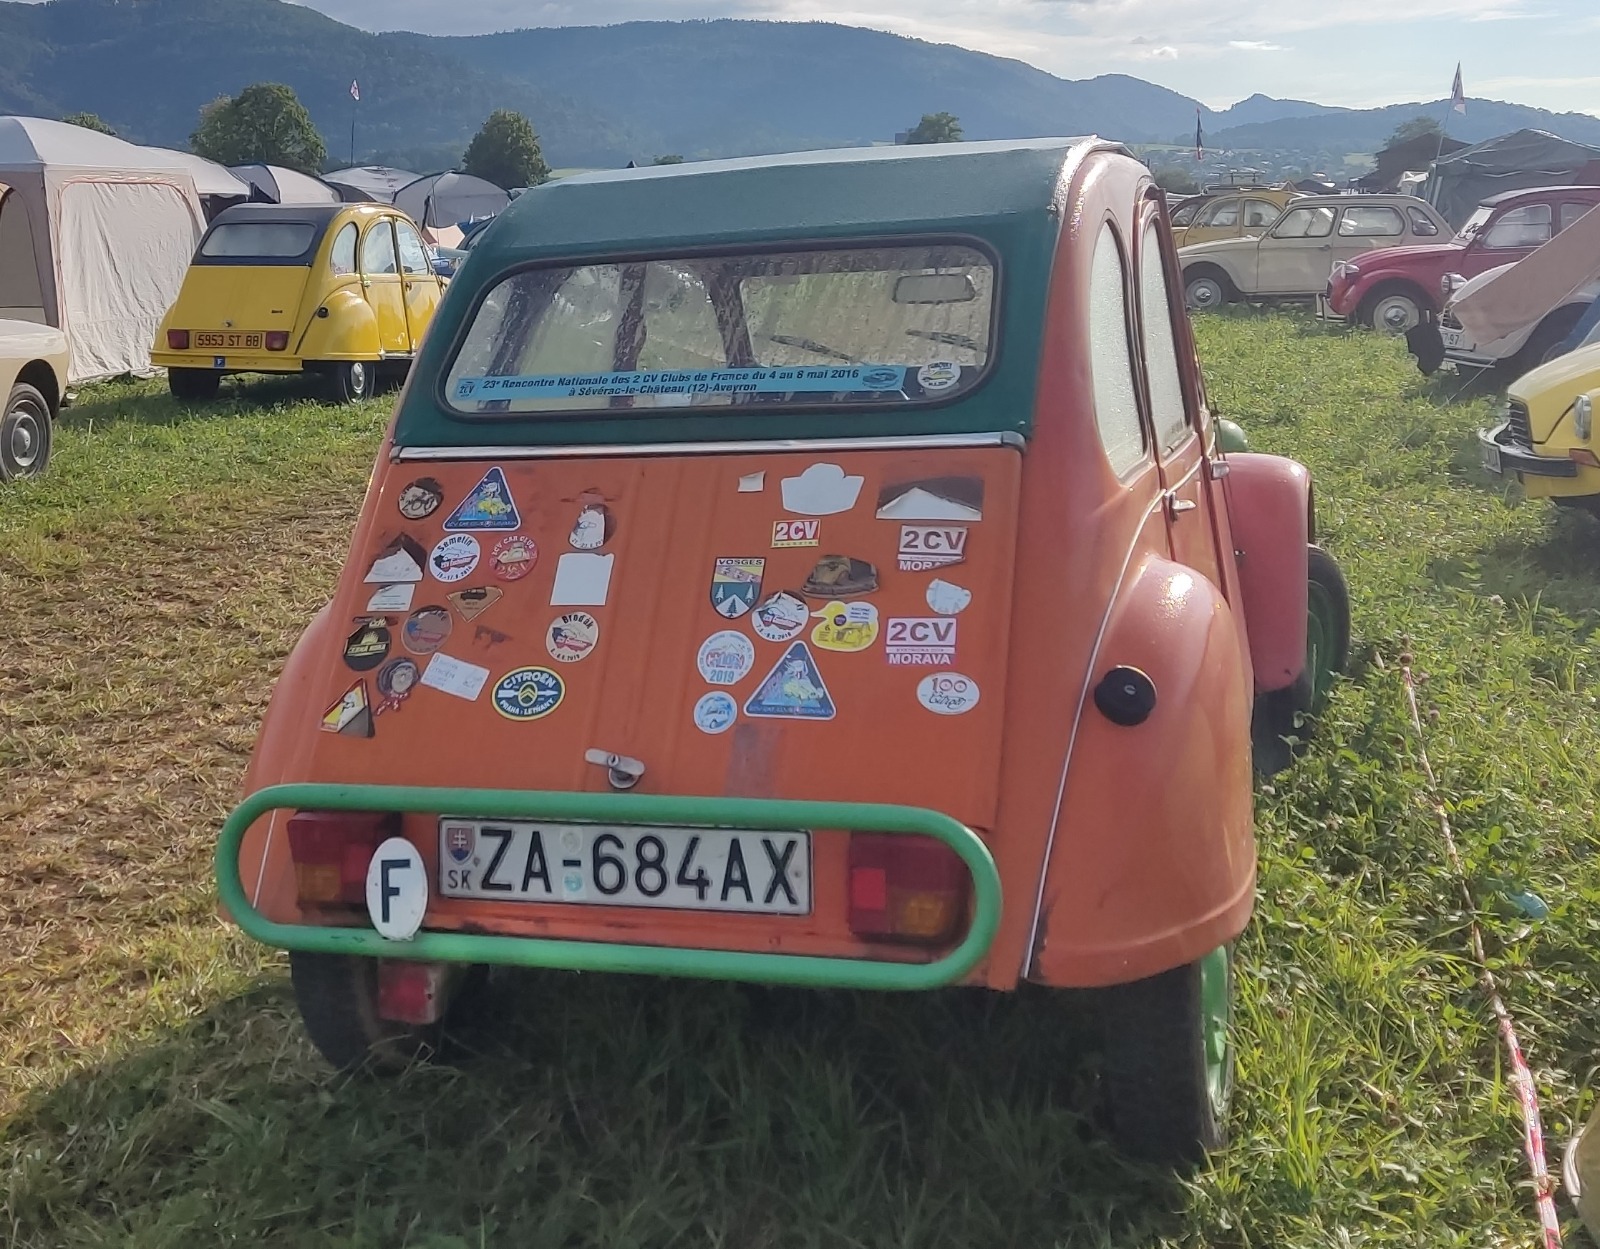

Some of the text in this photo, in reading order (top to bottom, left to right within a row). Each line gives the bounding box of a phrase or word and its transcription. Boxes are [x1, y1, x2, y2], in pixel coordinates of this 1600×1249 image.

[197, 334, 224, 346] 5953
[228, 335, 241, 347] ST
[501, 378, 555, 389] Rencontre
[557, 376, 609, 386] Nationale
[611, 375, 631, 384] des
[633, 374, 641, 383] 2
[643, 373, 658, 383] CV
[661, 373, 692, 383] Clubs
[694, 372, 708, 381] de
[711, 371, 749, 381] France
[752, 370, 766, 380] du
[769, 370, 777, 379] 4
[779, 371, 793, 379] au
[806, 370, 829, 379] mai
[830, 369, 860, 379] 2016
[775, 521, 818, 540] 2CV
[902, 530, 965, 550] 2CV
[889, 621, 954, 642] 2CV
[888, 653, 951, 665] MORAVA
[709, 669, 735, 683] 2019
[447, 868, 472, 889] SK
[380, 858, 411, 924] F
